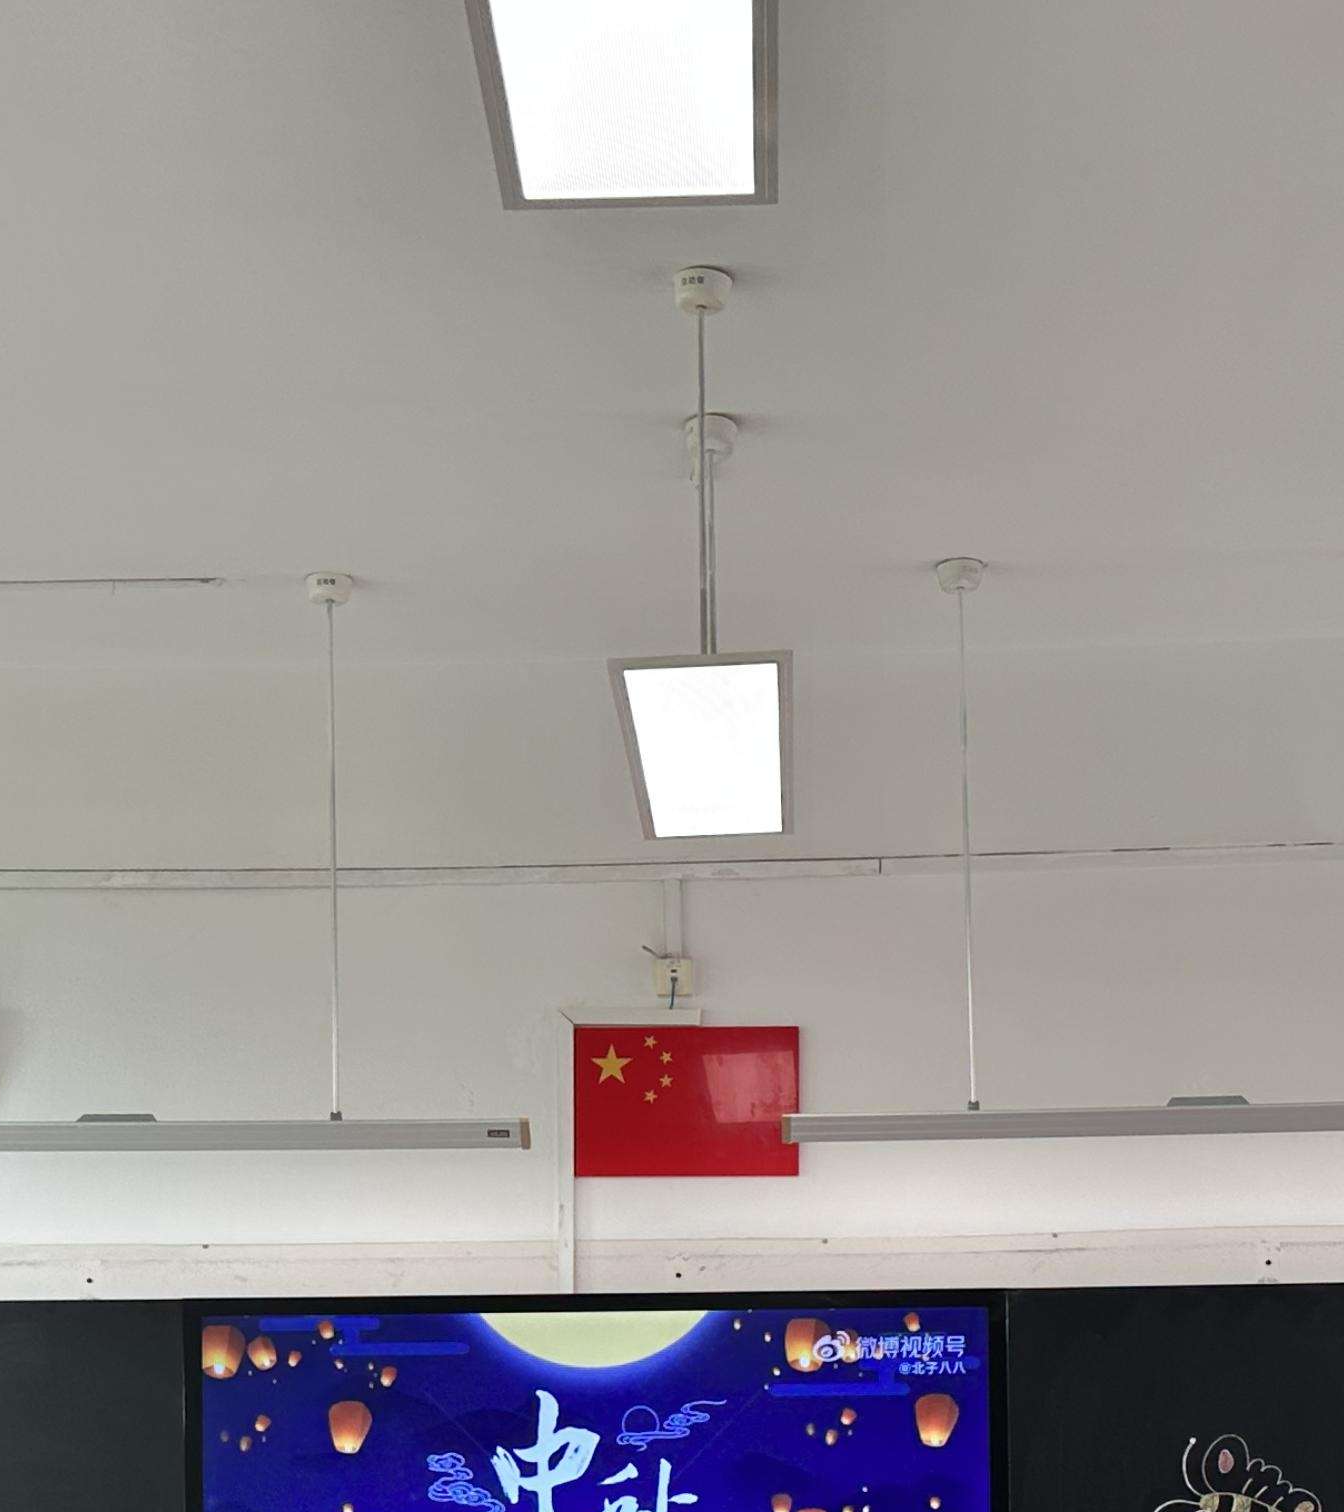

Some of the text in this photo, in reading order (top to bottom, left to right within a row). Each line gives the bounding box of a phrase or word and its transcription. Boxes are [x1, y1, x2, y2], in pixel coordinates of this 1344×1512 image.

[858, 1334, 967, 1361] 微博视频号
